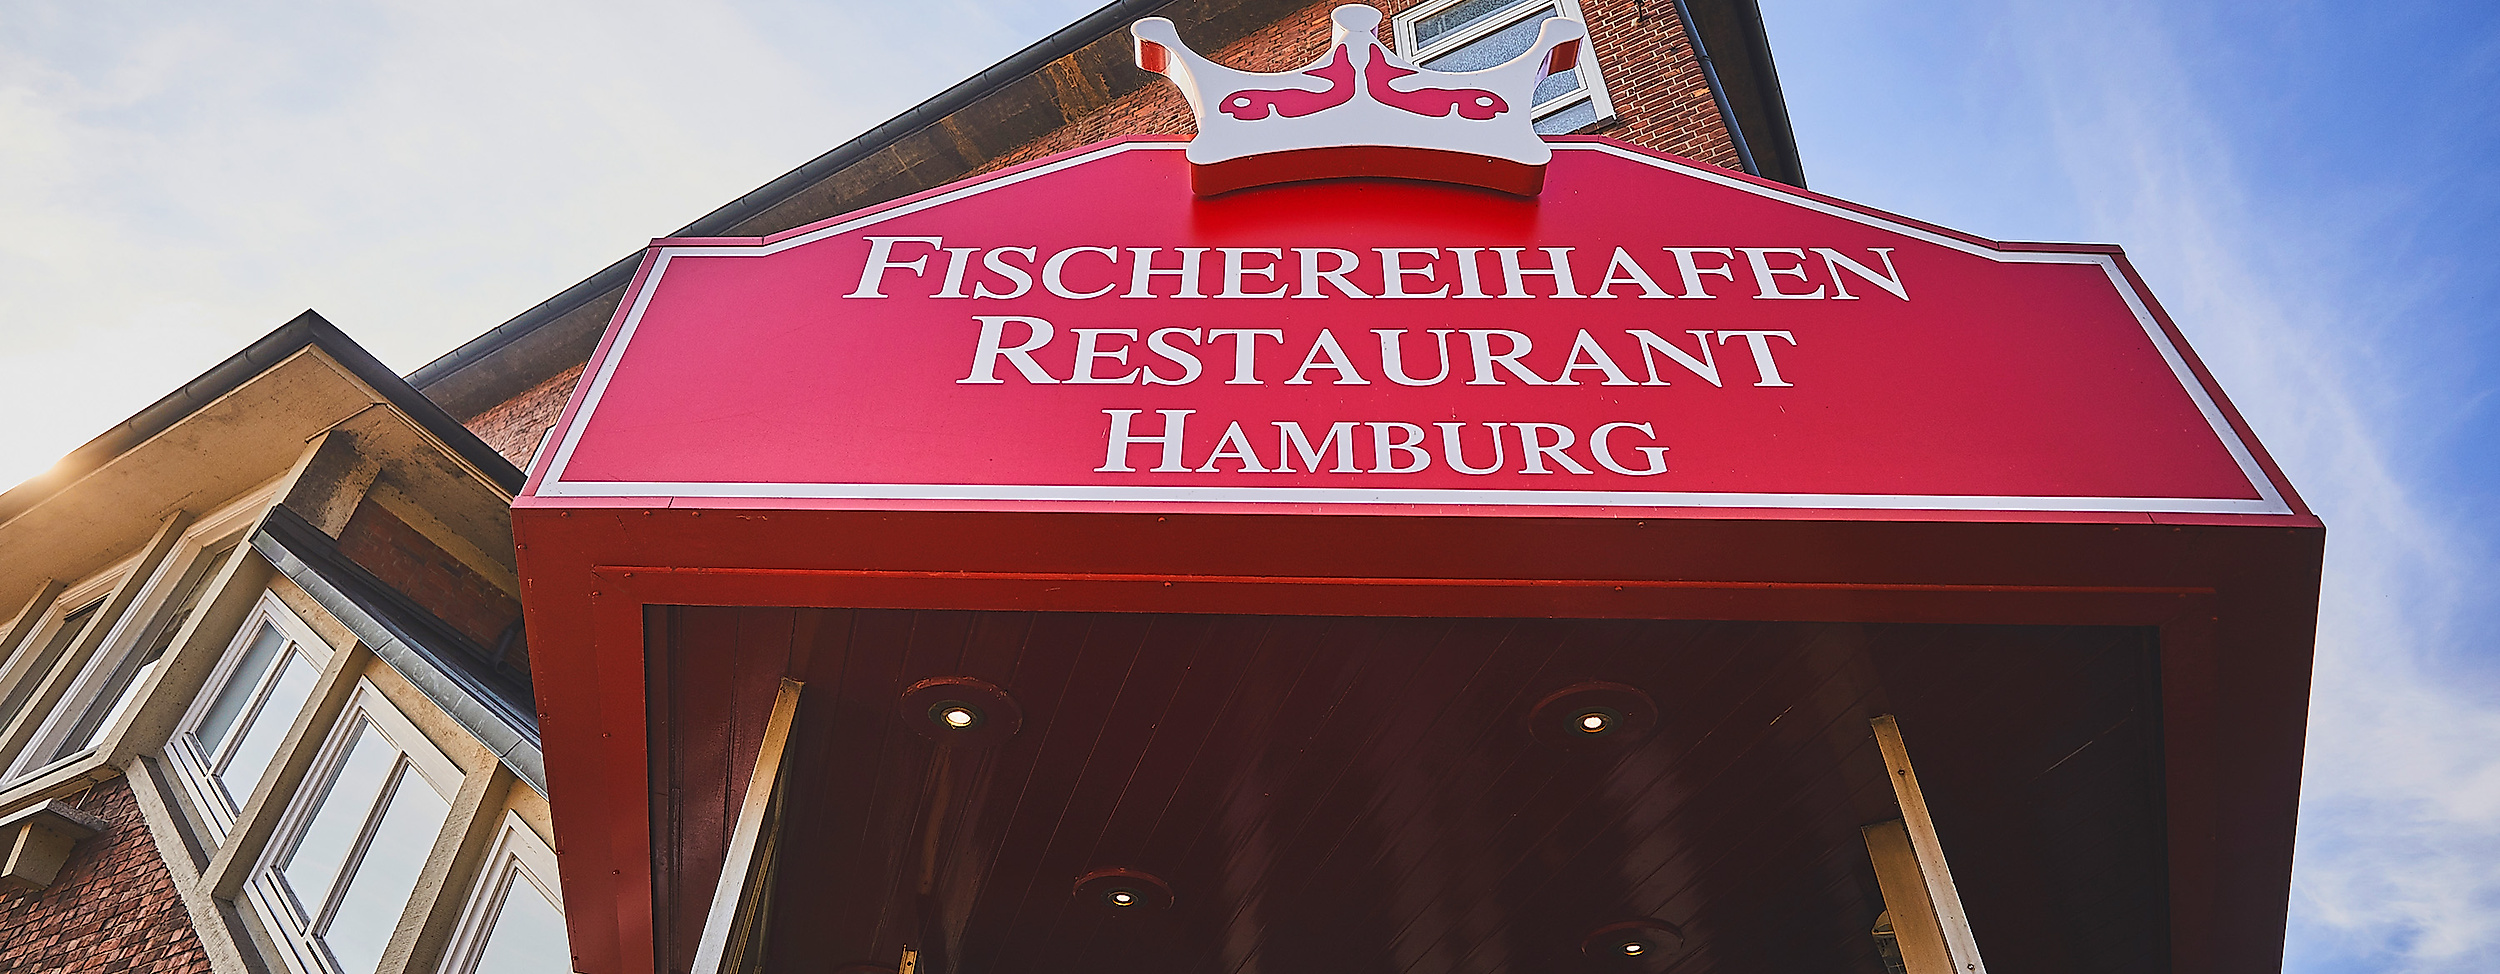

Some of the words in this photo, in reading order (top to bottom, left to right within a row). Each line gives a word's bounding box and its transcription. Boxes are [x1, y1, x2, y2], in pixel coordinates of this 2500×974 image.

[843, 235, 1910, 301] FISCHEREIHAFEN
[956, 315, 1797, 388] RESTAURANT
[1094, 409, 1670, 476] HAMBURG
